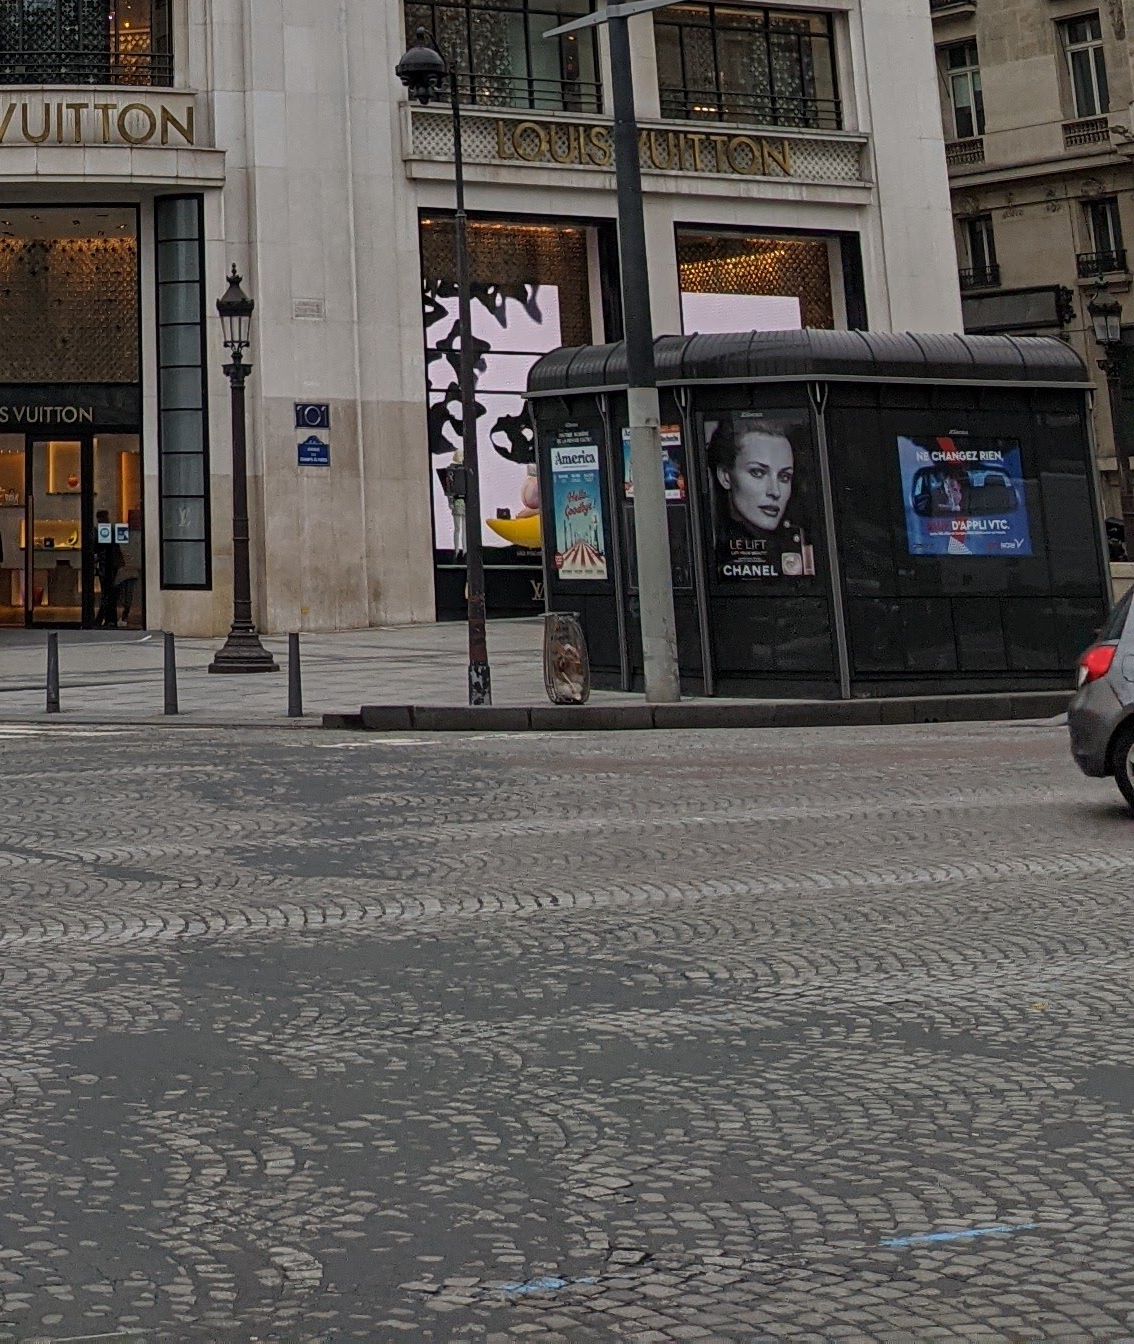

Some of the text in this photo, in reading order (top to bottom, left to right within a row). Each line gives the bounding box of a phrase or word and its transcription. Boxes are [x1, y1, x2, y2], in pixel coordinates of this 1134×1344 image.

[496, 120, 611, 166] LOUIS
[12, 406, 93, 423] VUITTON
[555, 449, 596, 465] America
[931, 451, 978, 461] CHANGEZ
[980, 451, 1004, 462] RIEN,
[952, 519, 987, 531] D'APPLI
[988, 518, 1010, 530] VTC.
[730, 540, 767, 550] LE LIFT
[723, 564, 779, 577] CHANEL
